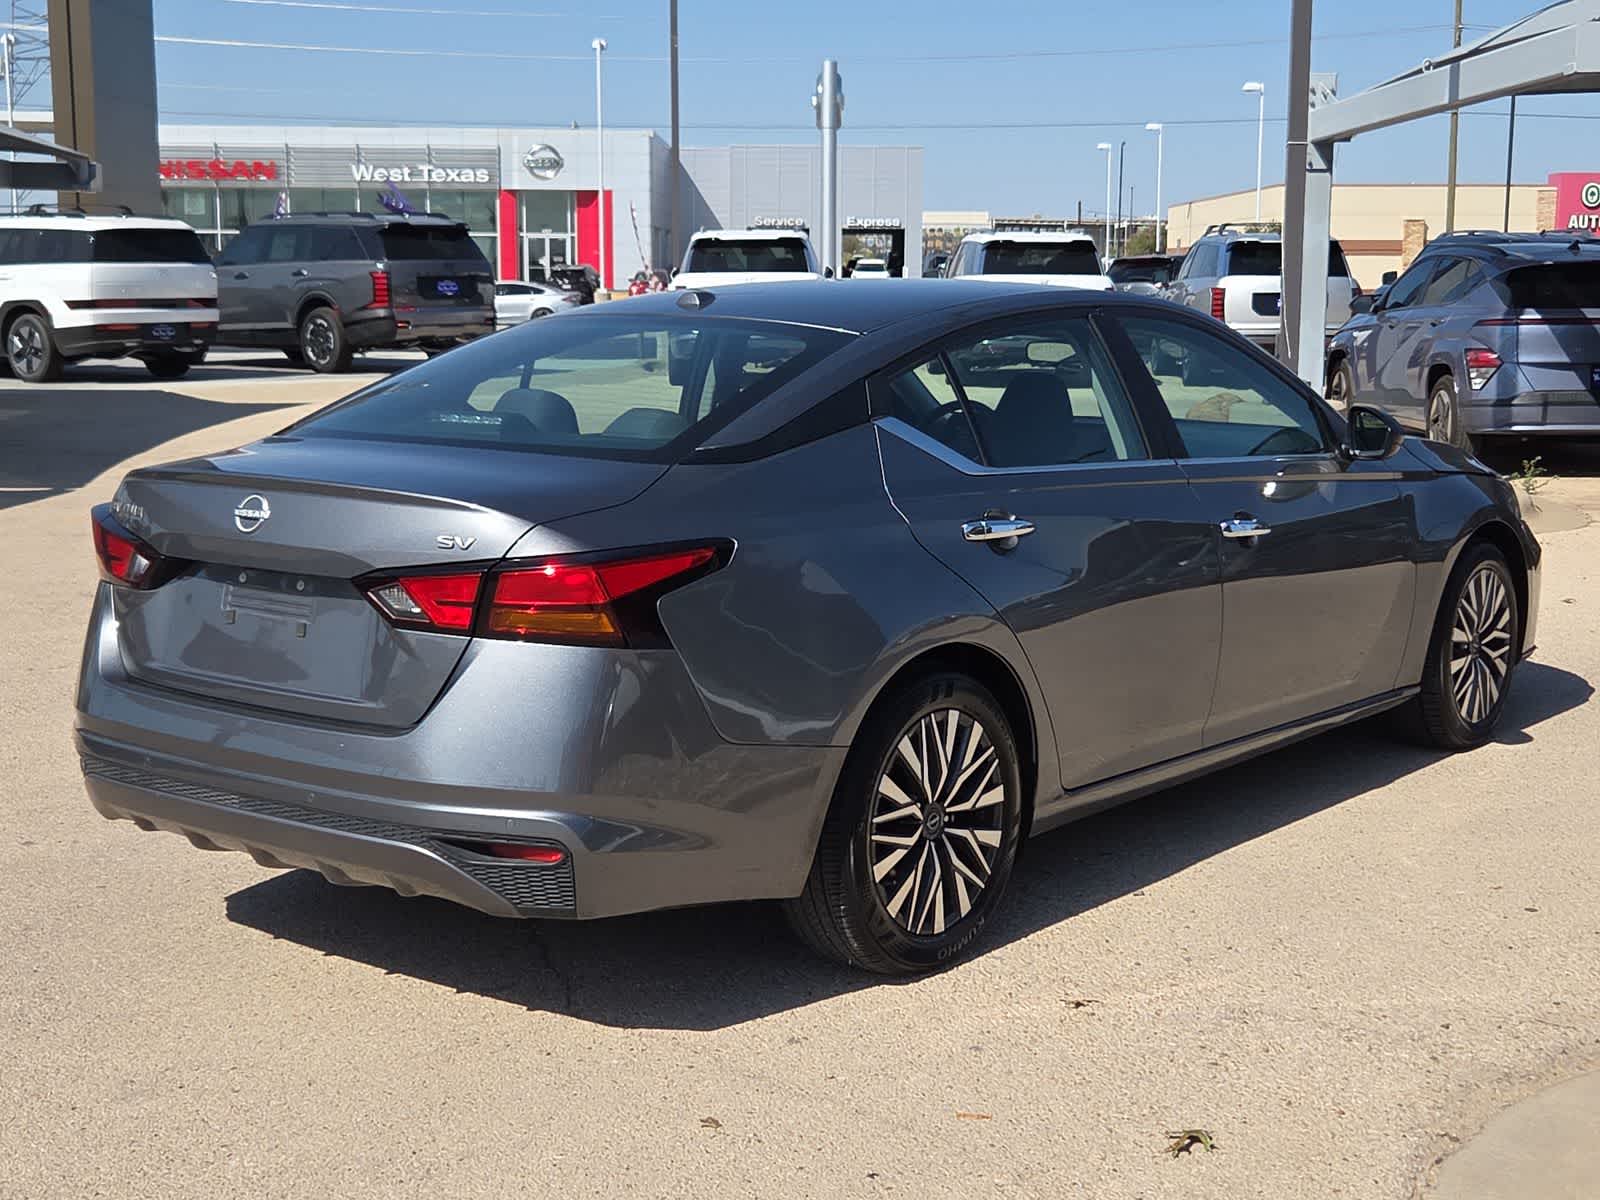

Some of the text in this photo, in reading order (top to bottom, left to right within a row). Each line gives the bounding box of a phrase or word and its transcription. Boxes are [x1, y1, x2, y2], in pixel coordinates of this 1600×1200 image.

[159, 160, 276, 180] NISSAN
[351, 164, 490, 182] West Texas
[753, 215, 902, 229] Service Express
[1568, 214, 1600, 229] AUT
[436, 535, 479, 551] SV
